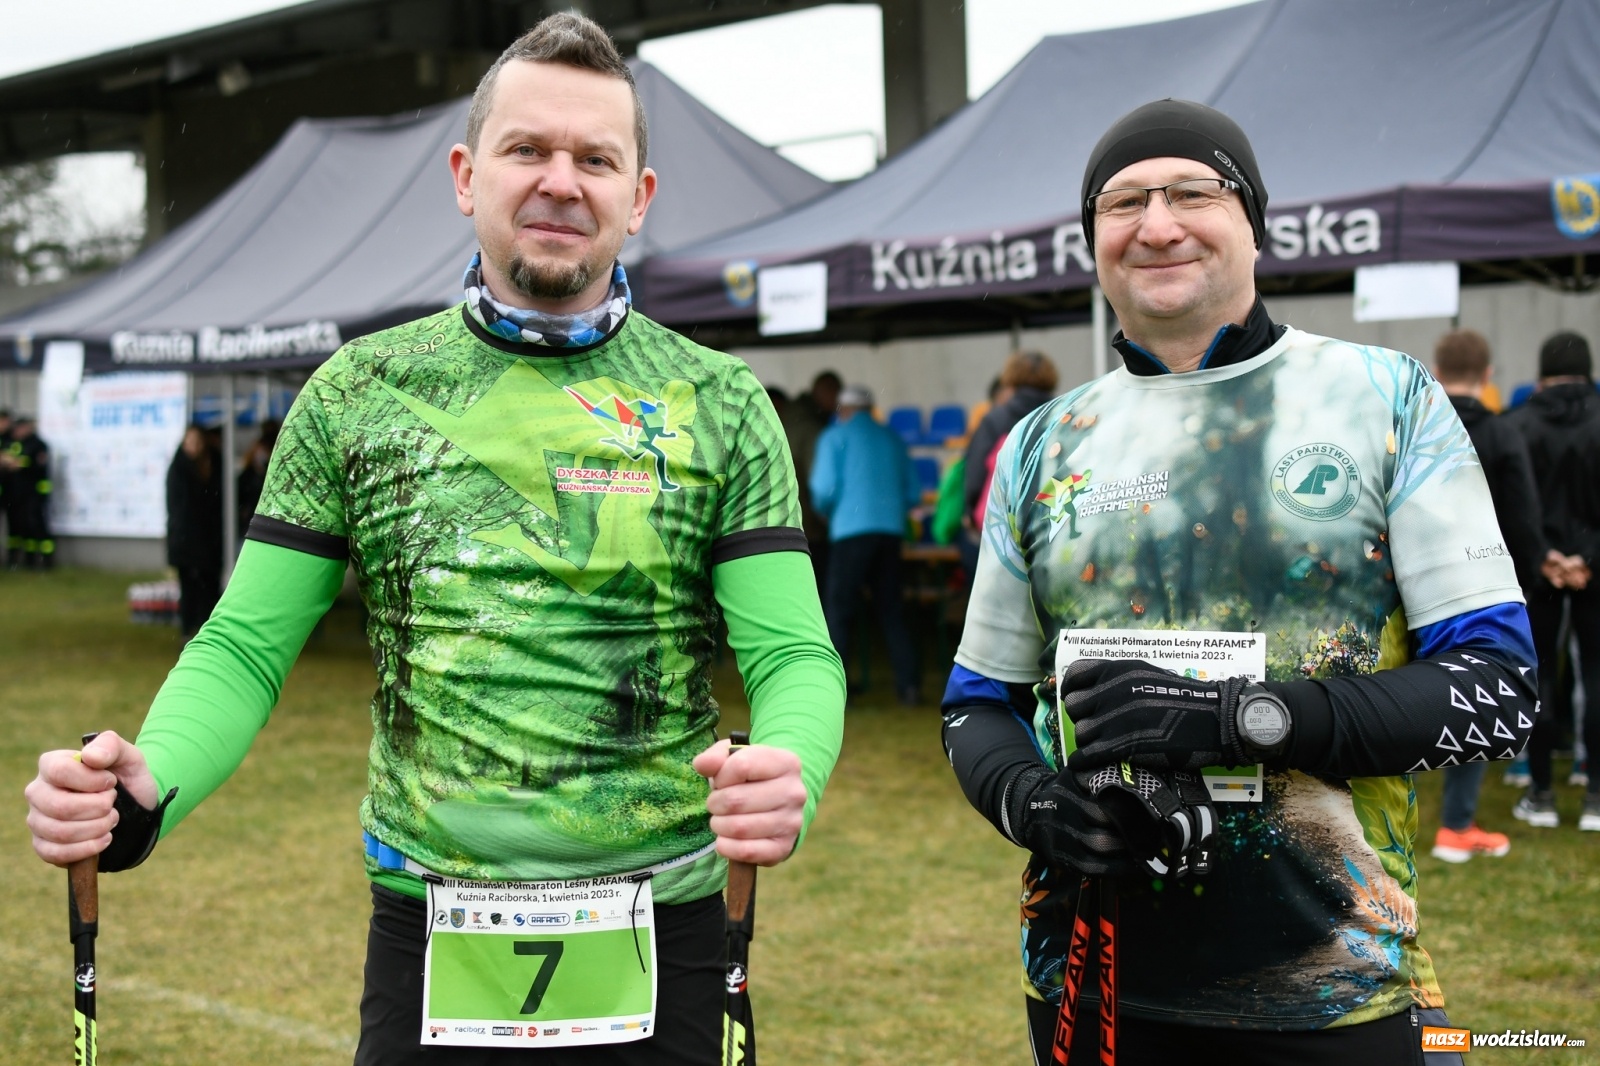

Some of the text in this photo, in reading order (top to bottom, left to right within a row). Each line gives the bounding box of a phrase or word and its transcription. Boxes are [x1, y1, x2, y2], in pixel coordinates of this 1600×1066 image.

[871, 230, 1038, 291] Kuźnia
[1275, 444, 1358, 481] LASY PAŃSTWOWE
[557, 468, 650, 481] DYSZKA Z KIJA
[610, 486, 650, 494] ZADYSZKA
[1082, 482, 1168, 506] PÓŁMARATON
[1080, 499, 1140, 518] RAFAMET
[1067, 636, 1253, 649] VIII Kuźniański Półmaraton Leśny RAFAMET
[1079, 648, 1103, 657] Kuźnia
[1105, 649, 1150, 659] Raciborska,
[1152, 651, 1157, 659] 1
[1159, 650, 1199, 659] kwietnia
[1201, 651, 1225, 660] 2023
[457, 879, 506, 889] Kuźniański
[507, 880, 562, 890] Półmaraton
[564, 878, 590, 890] Leśny
[592, 875, 634, 887] RAFAME
[456, 889, 622, 903] Kuźnia Raciborska, 1 kwietnia 2023 r.
[531, 915, 567, 924] RAFAMET
[513, 940, 564, 1015] 7
[1055, 928, 1088, 1055] FIZAN
[1100, 928, 1113, 1057] FIZAN
